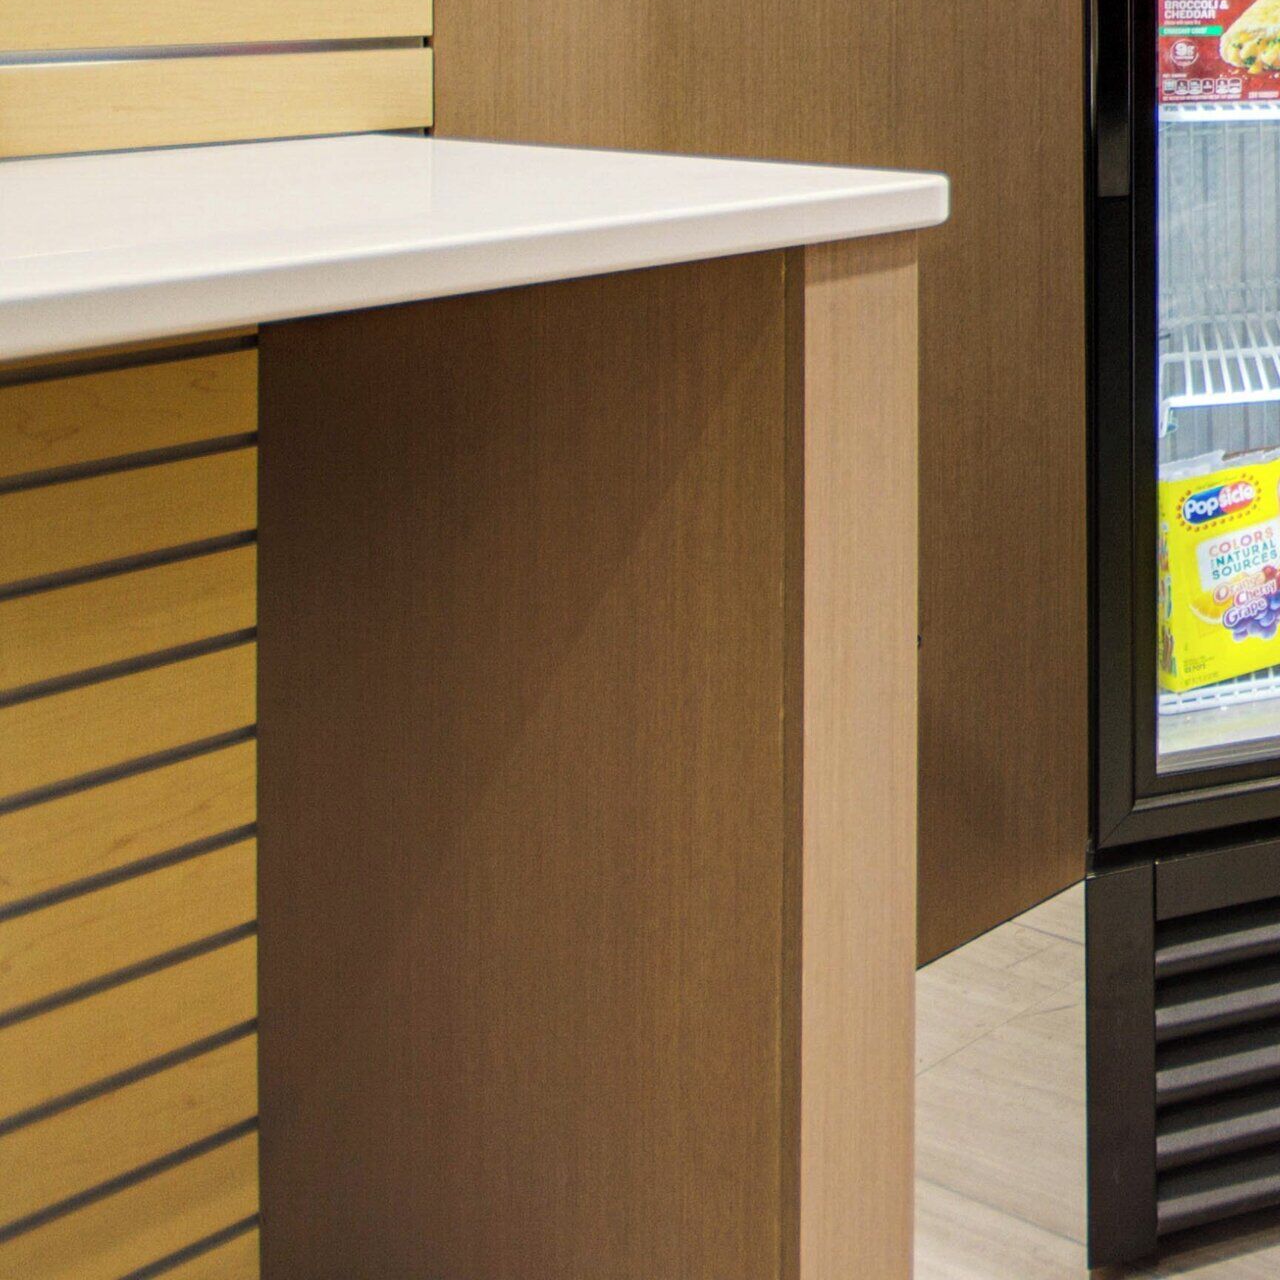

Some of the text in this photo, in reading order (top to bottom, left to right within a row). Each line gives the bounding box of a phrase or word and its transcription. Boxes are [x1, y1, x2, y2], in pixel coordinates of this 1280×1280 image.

[1164, 0, 1229, 10] BROCCOLI &
[1164, 9, 1216, 20] CHEDDAR
[1185, 481, 1255, 517] Popsicle
[1209, 527, 1274, 557] COLORS
[1216, 539, 1276, 566] NATURAL
[1212, 549, 1278, 580] SOURCES
[1214, 571, 1266, 604] Orange
[1234, 579, 1277, 607] Cherry
[1224, 598, 1267, 627] Grape
